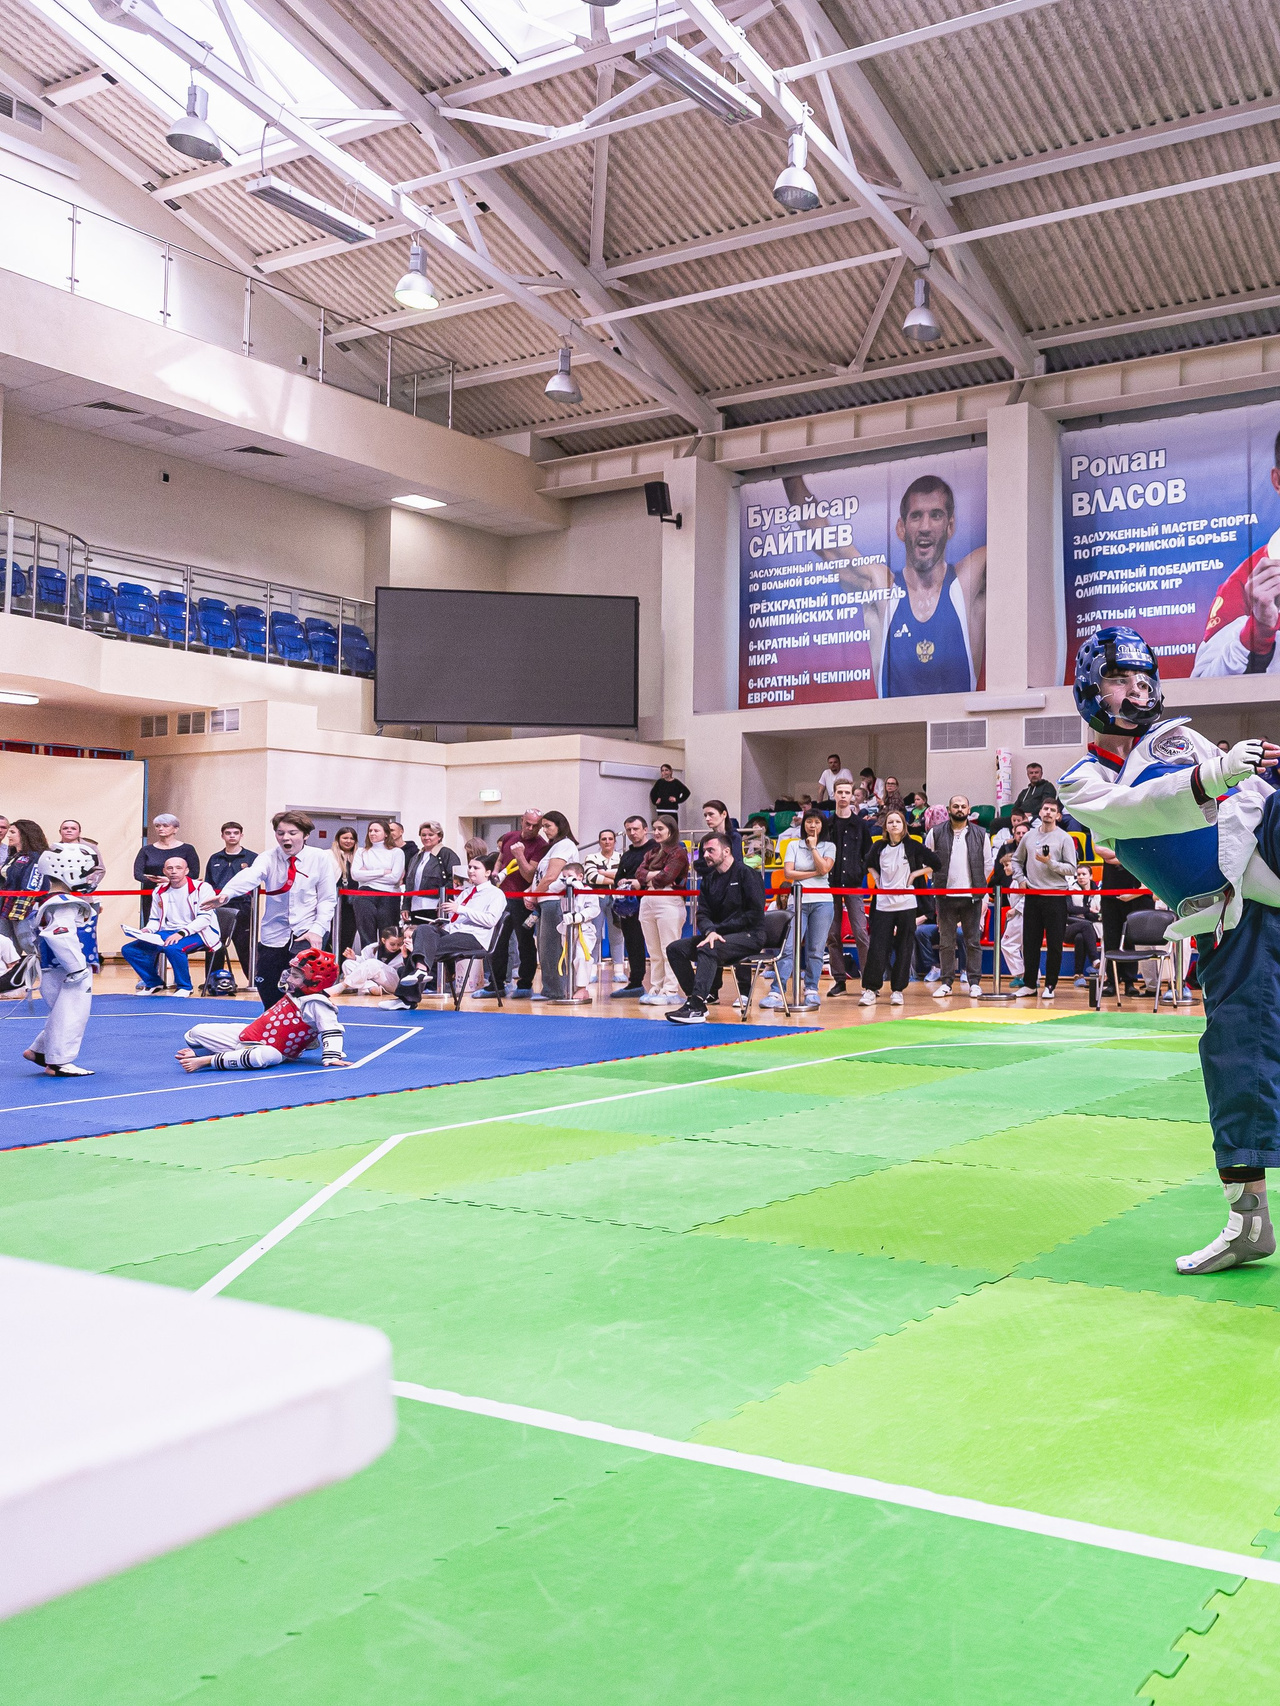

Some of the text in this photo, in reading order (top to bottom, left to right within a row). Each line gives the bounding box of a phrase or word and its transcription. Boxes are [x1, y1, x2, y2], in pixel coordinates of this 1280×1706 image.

[1070, 448, 1167, 480] Роман
[1071, 478, 1187, 517] ВЛАСОВ
[747, 496, 859, 531] Бувайсар
[1073, 513, 1258, 546] ЗАСЛУЖЕННЫЙ МАСТЕР СПОРТА
[749, 525, 853, 558] САЙТИЕВ
[1073, 530, 1237, 560] ПО ГРЕКО-РИМСКОЙ БОРЬБЕ
[749, 554, 886, 579] ЗАСЛУЖЕННЫЙ МАСТЕР СПОРТА
[1074, 559, 1224, 587] ДВУКРАТНЫЙ ПОБЕДИТЕЛЬ
[748, 573, 840, 592] ПО ВОЛЬНОЙ БОРЬБЕ
[1075, 578, 1183, 599] ОЛИМПИЙСКИХ ИГР
[749, 587, 906, 614] ТРЁХКРАТНЫЙ ПОБЕДИТЕЛЬ
[749, 607, 858, 629] ОЛИМПИЙСКИХ ИГР
[1076, 603, 1196, 624] 3-КРАТНЫЙ ЧЕМПИОН
[748, 629, 871, 651] 6-КРАТНЫЙ ЧЕМПИОН
[1076, 624, 1102, 638] МИРА
[748, 653, 778, 666] МИРА
[1150, 644, 1196, 657] МПИОН
[748, 668, 871, 689] 6-КРАТНЫЙ ЧЕМПИОН
[747, 690, 794, 704] ЕВРОПЫ
